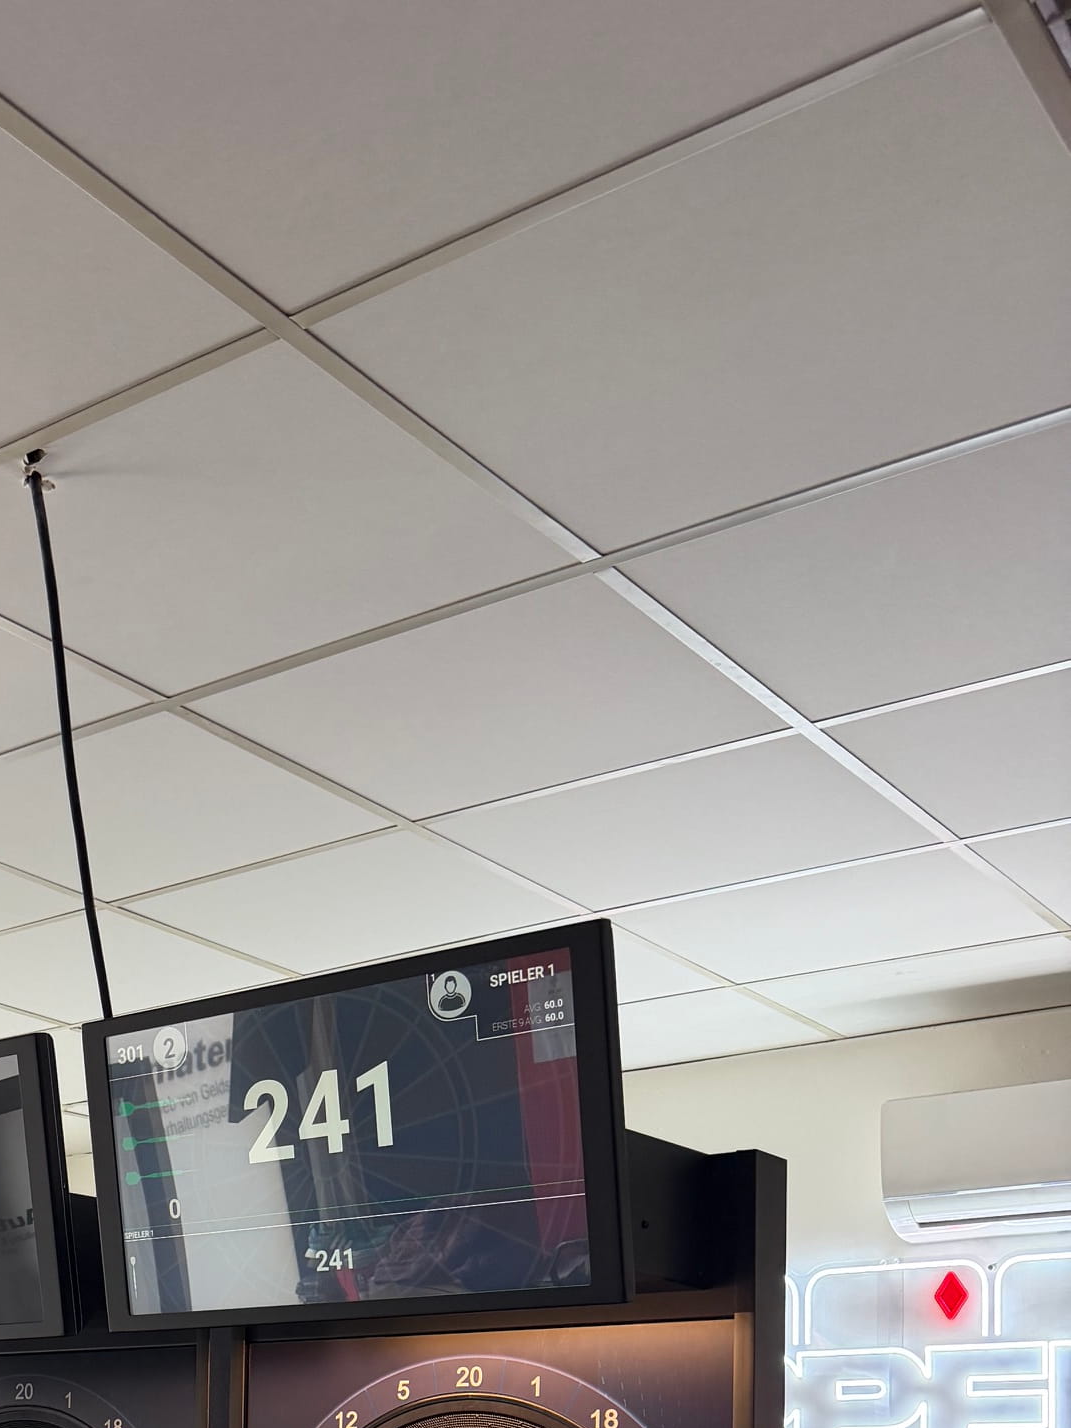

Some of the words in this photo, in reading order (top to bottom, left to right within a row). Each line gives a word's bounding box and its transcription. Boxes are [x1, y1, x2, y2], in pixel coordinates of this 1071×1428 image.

[430, 974, 435, 982] 1
[489, 966, 544, 987] SPIELER
[547, 963, 555, 977] 1
[544, 998, 563, 1010] 60.0
[492, 1018, 517, 1032] ERSTE
[545, 1011, 564, 1022] 60.0
[117, 1044, 144, 1065] 301
[163, 1037, 176, 1059] 2
[242, 1060, 394, 1165] 241
[169, 1198, 181, 1219] 0
[316, 1247, 354, 1272] 241
[455, 1365, 483, 1387] 20
[530, 1375, 541, 1397] 1
[15, 1383, 34, 1401] 20
[65, 1391, 72, 1409] 1
[397, 1379, 410, 1401] 5
